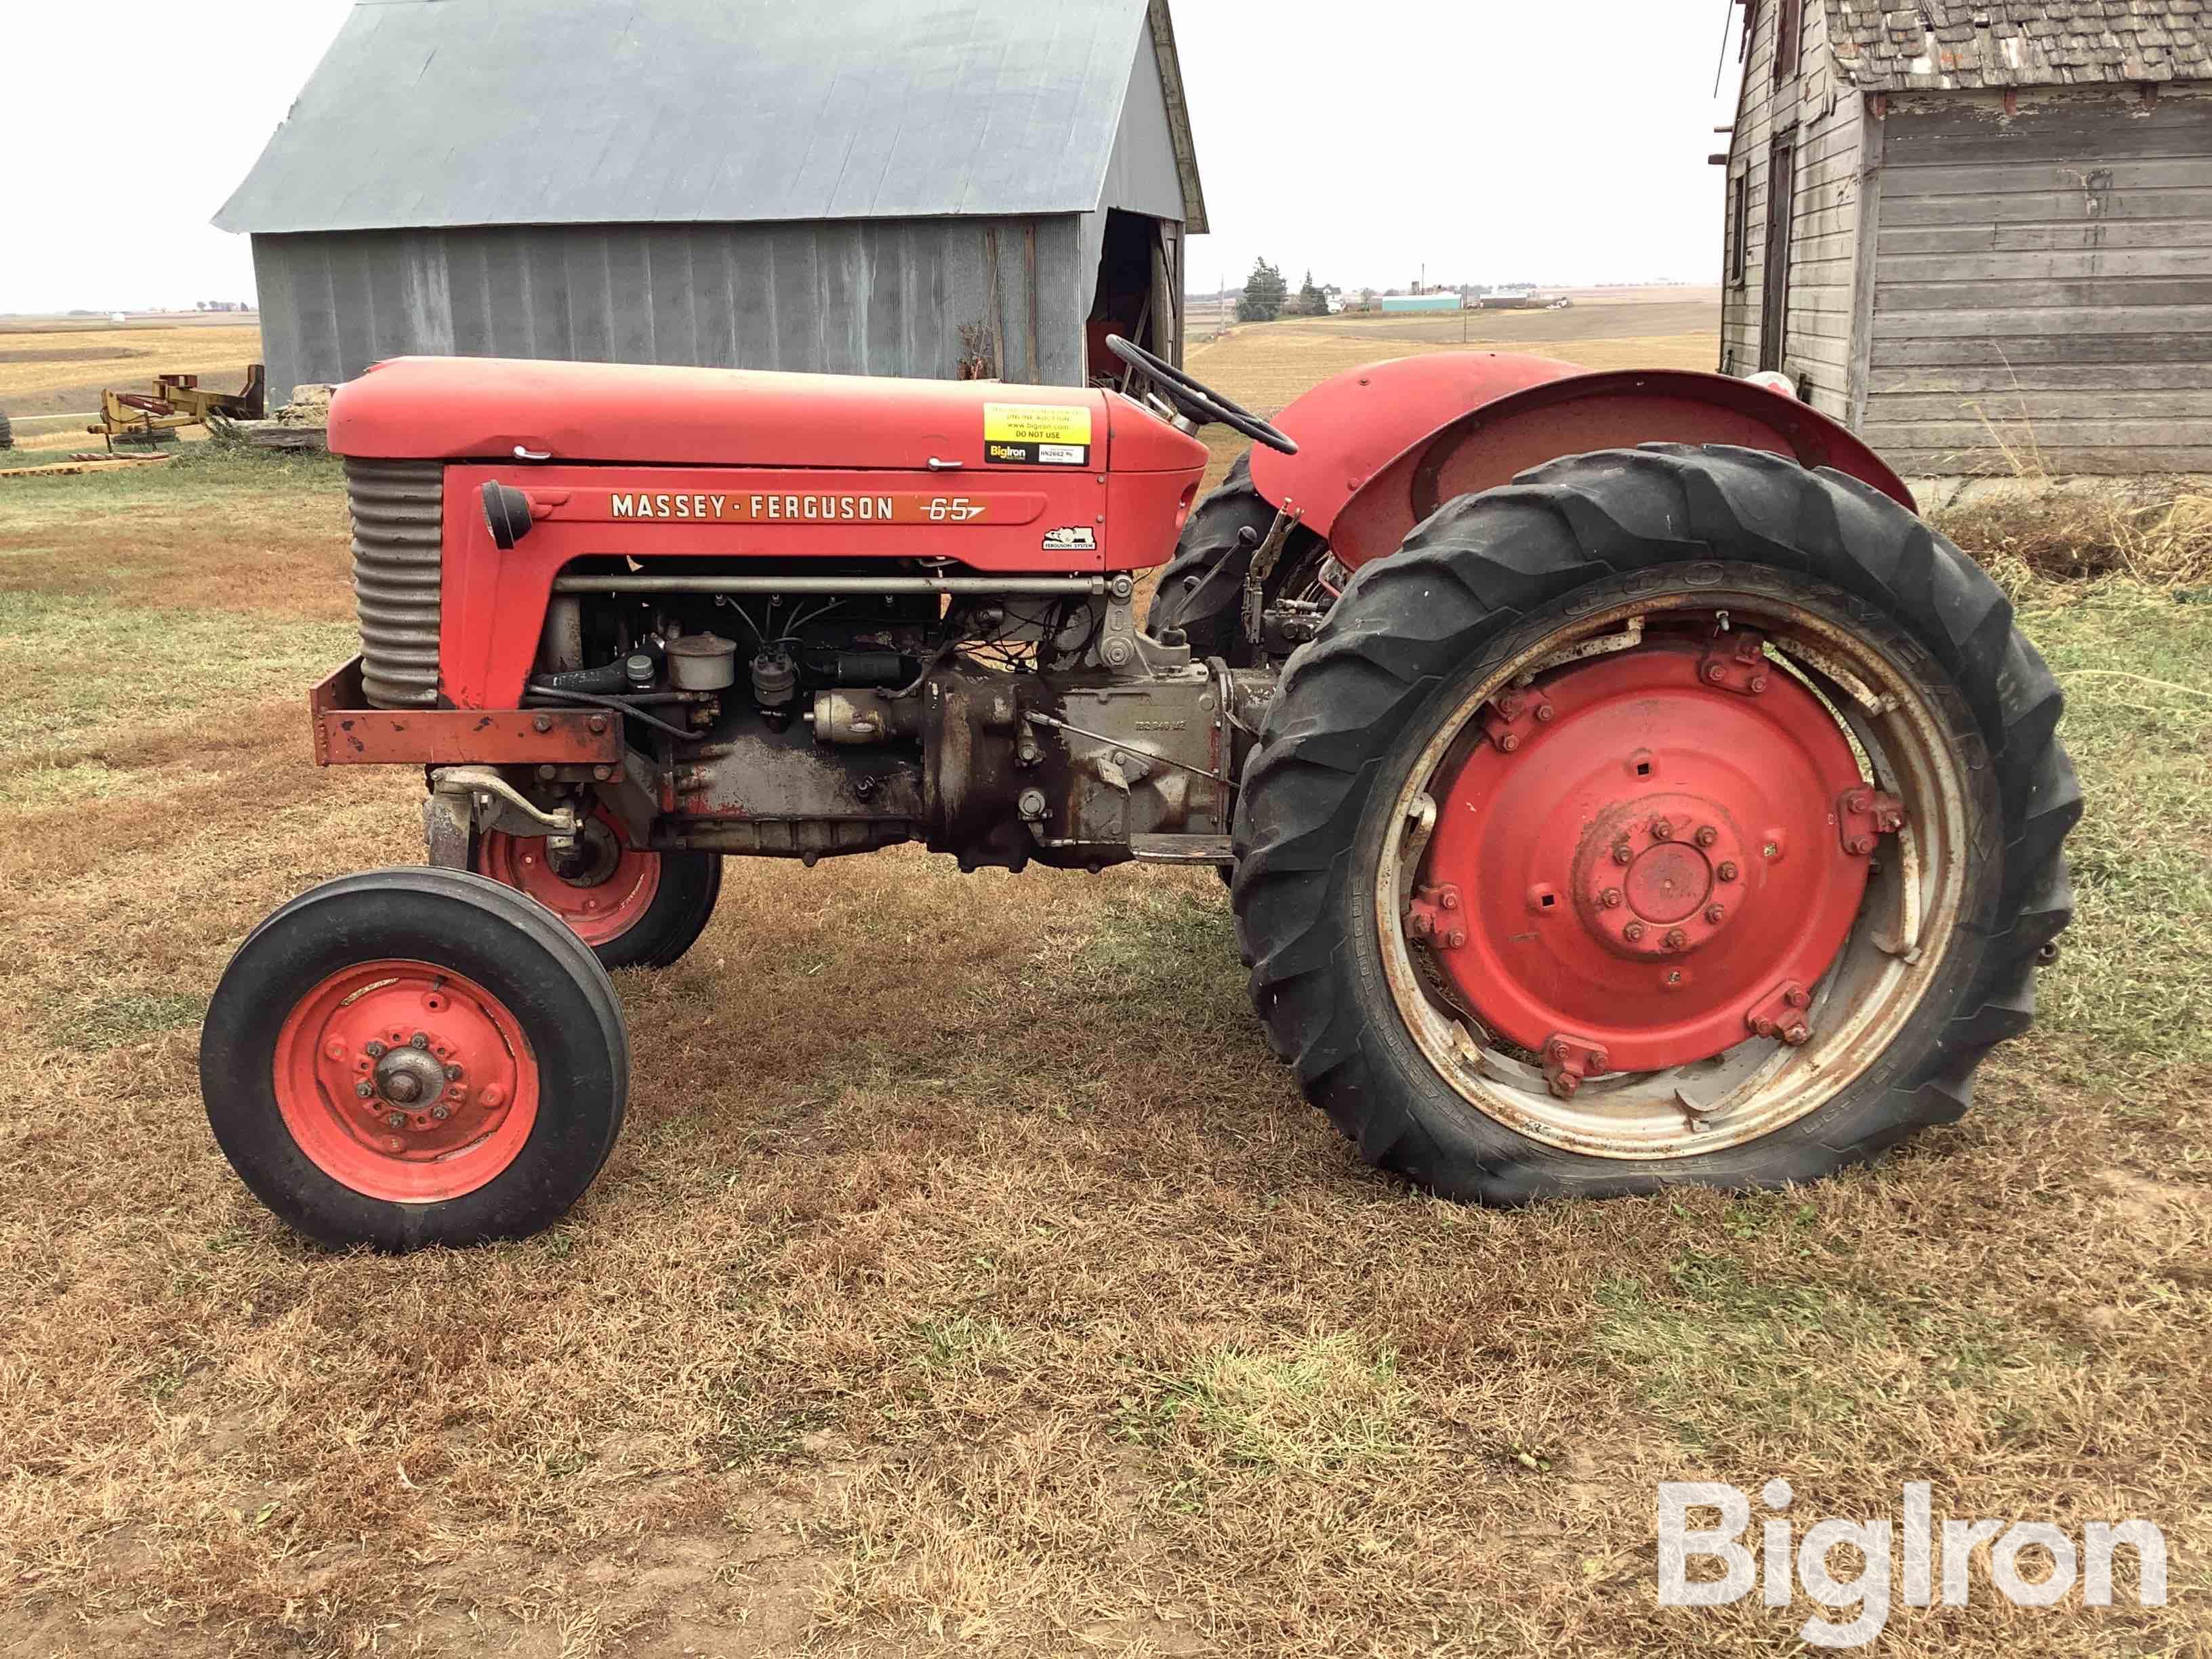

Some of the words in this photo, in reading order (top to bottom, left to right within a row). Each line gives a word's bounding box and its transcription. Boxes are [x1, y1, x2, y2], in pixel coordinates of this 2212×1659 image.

[991, 445, 1025, 459] BigIron
[611, 494, 726, 518] MASSEY
[750, 495, 893, 520] FERGUSON
[929, 498, 969, 520] 65
[1351, 877, 1376, 998] TORQUE
